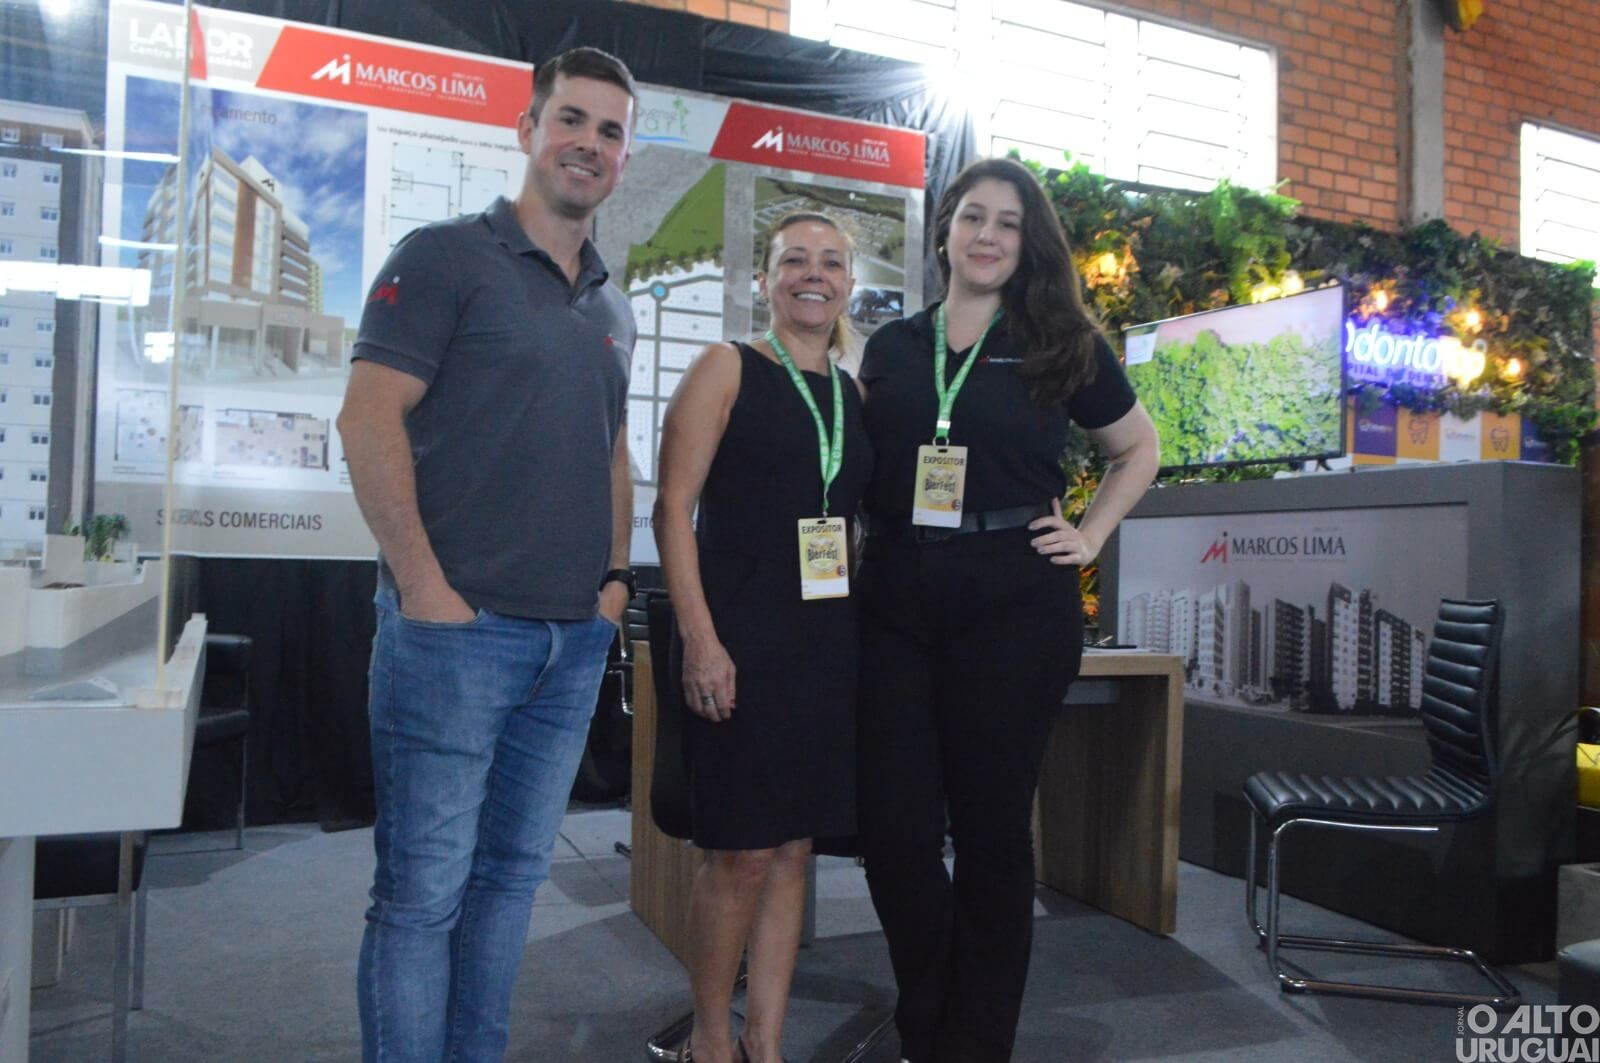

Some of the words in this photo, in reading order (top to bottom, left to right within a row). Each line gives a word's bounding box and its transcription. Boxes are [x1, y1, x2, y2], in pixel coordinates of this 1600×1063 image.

[355, 62, 437, 92] MARCOS
[441, 77, 487, 101] LIMA
[786, 132, 850, 156] MARCOS
[853, 143, 890, 163] LIMA
[922, 455, 965, 466] EXPOSITOR
[219, 510, 322, 531] COMERCIAIS
[801, 523, 843, 535] EXPOSITOR
[1231, 536, 1298, 556] MARCOS
[1303, 535, 1347, 556] LIMA
